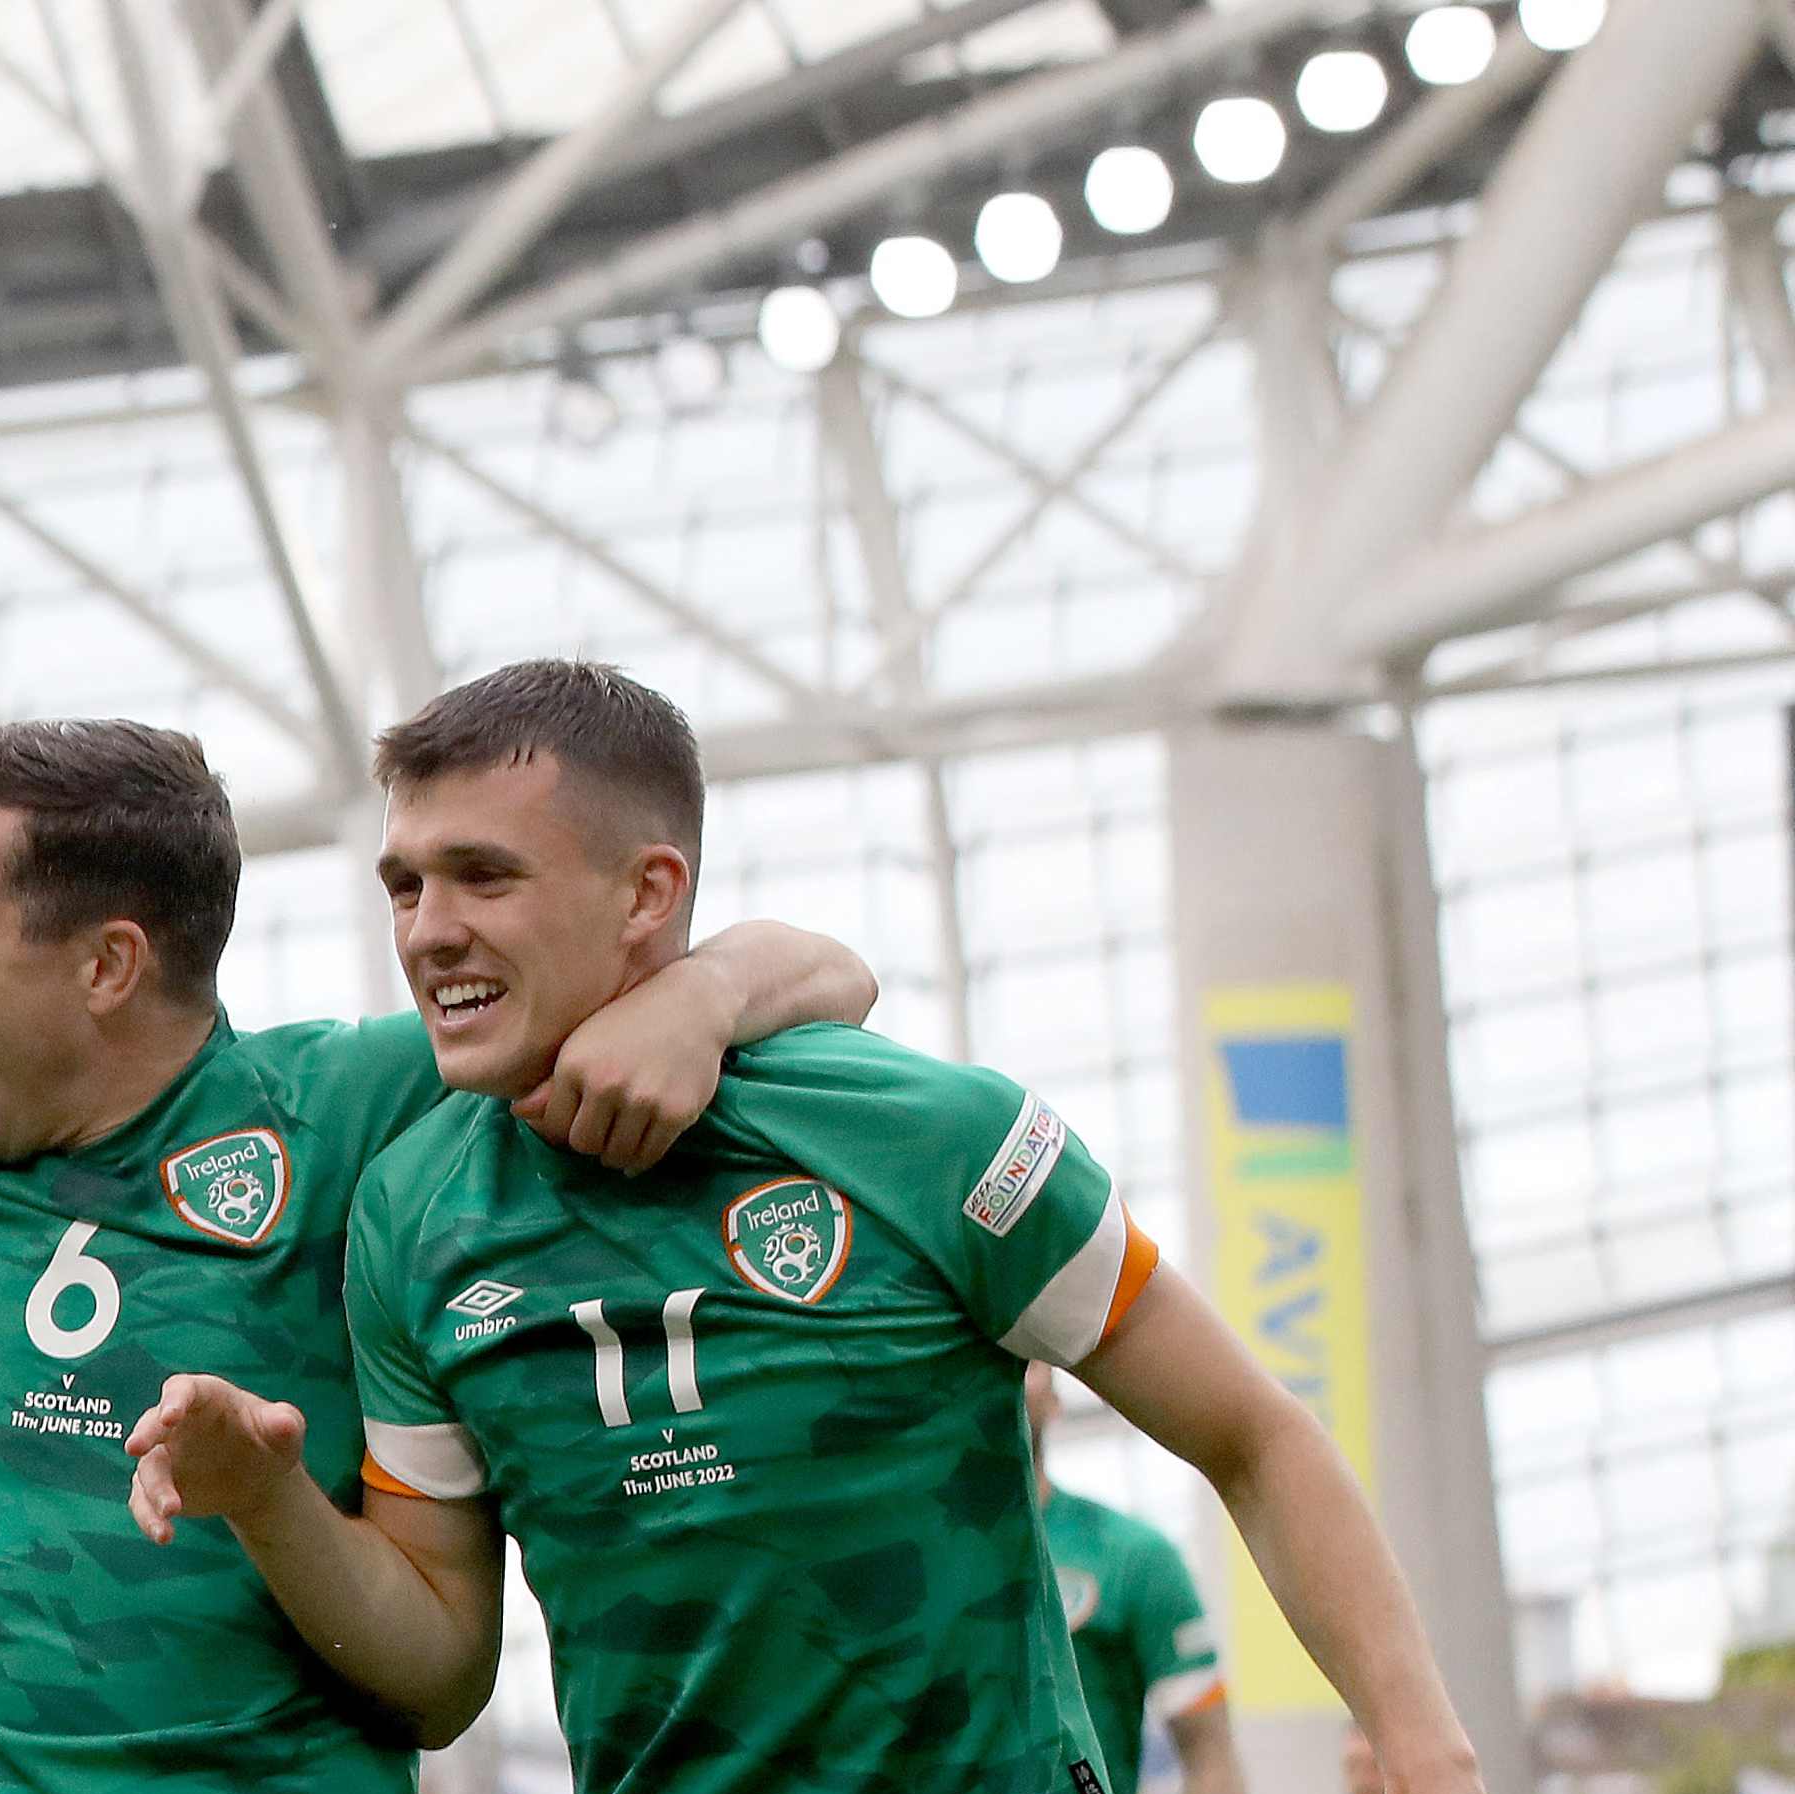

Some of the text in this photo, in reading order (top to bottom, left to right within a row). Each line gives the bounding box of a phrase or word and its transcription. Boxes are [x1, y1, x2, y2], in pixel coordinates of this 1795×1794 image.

[182, 1140, 260, 1181] Ireland
[741, 1189, 820, 1232] Ireland
[25, 1219, 121, 1360] 6
[454, 1315, 517, 1341] umbro
[24, 1391, 111, 1415] SCOTLAND
[39, 1415, 81, 1434] JUNE
[83, 1420, 123, 1439] 2022
[630, 1444, 718, 1472] SCOTLAND
[654, 1470, 695, 1494] JUNE
[696, 1464, 736, 1486] 2022
